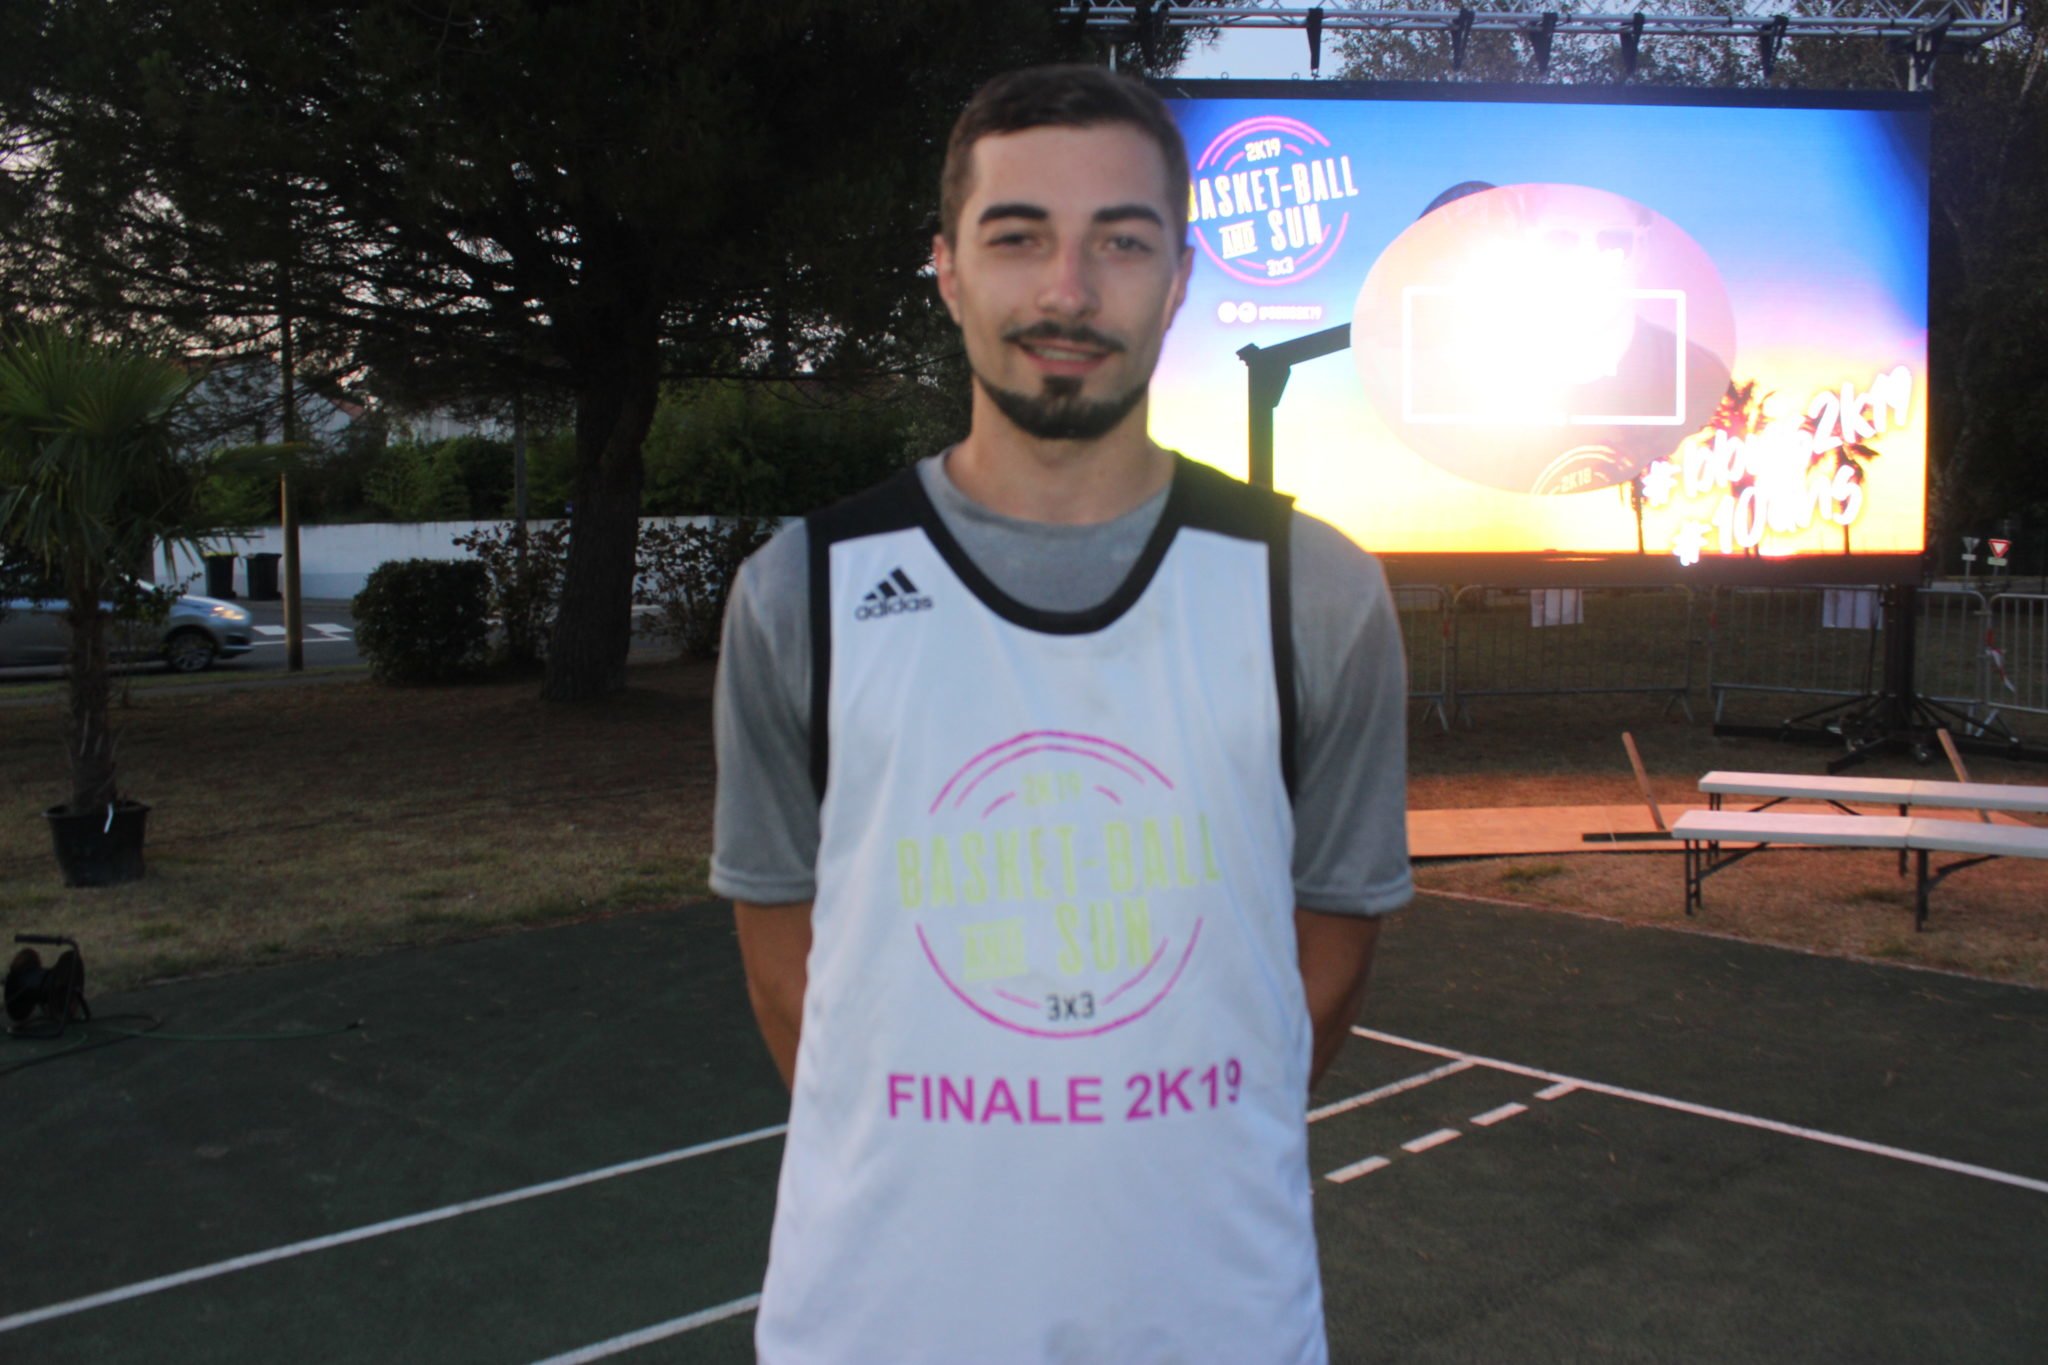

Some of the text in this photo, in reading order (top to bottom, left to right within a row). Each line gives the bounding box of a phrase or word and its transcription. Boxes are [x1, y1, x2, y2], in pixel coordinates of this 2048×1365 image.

[1267, 204, 1323, 252] SUN
[855, 596, 933, 621] adidas
[1022, 772, 1082, 806] 2K19
[897, 812, 1222, 910] BASKET-BALL
[1055, 897, 1152, 975] SUN
[887, 1057, 1243, 1125] FINALE 2K19
